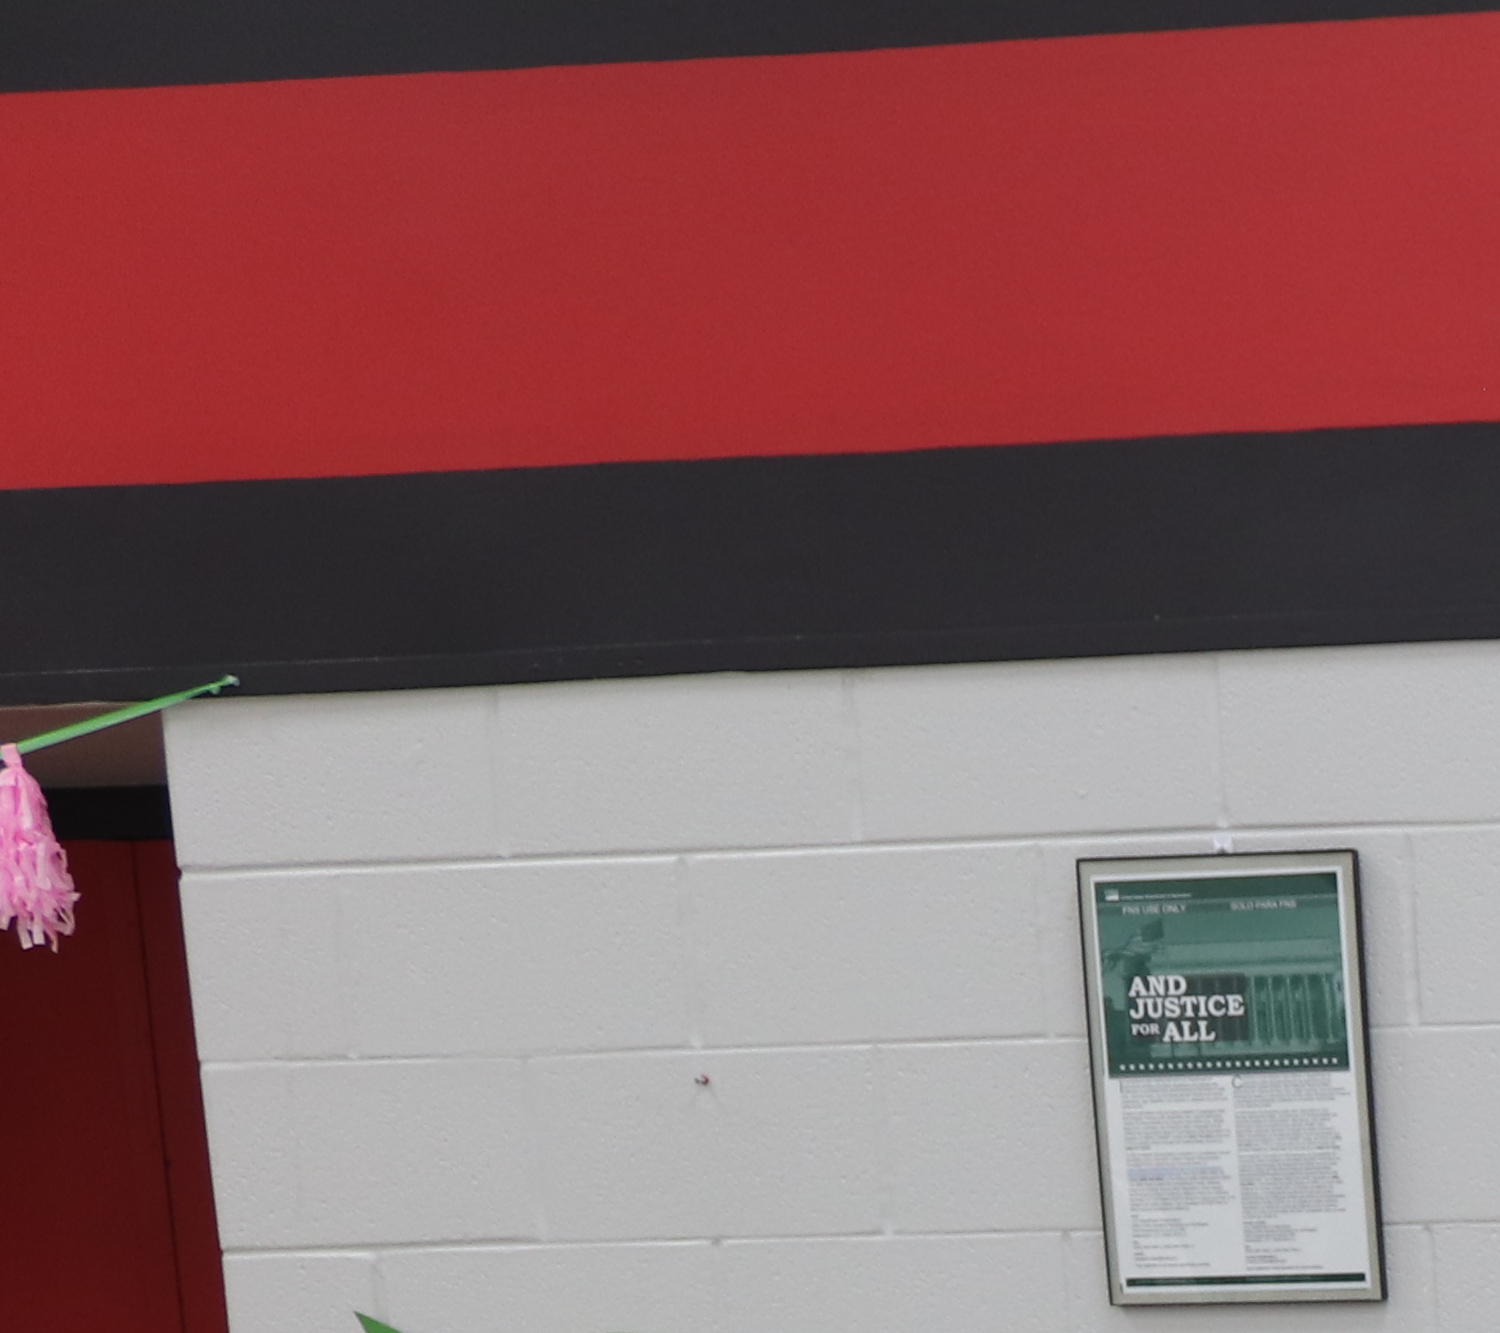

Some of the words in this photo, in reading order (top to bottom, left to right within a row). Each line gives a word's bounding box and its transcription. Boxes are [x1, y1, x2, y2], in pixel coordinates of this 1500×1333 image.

[1128, 974, 1187, 998] AND
[1129, 994, 1246, 1020] JUSTICE
[1131, 1023, 1161, 1036] FOR
[1162, 1020, 1216, 1043] ALL
